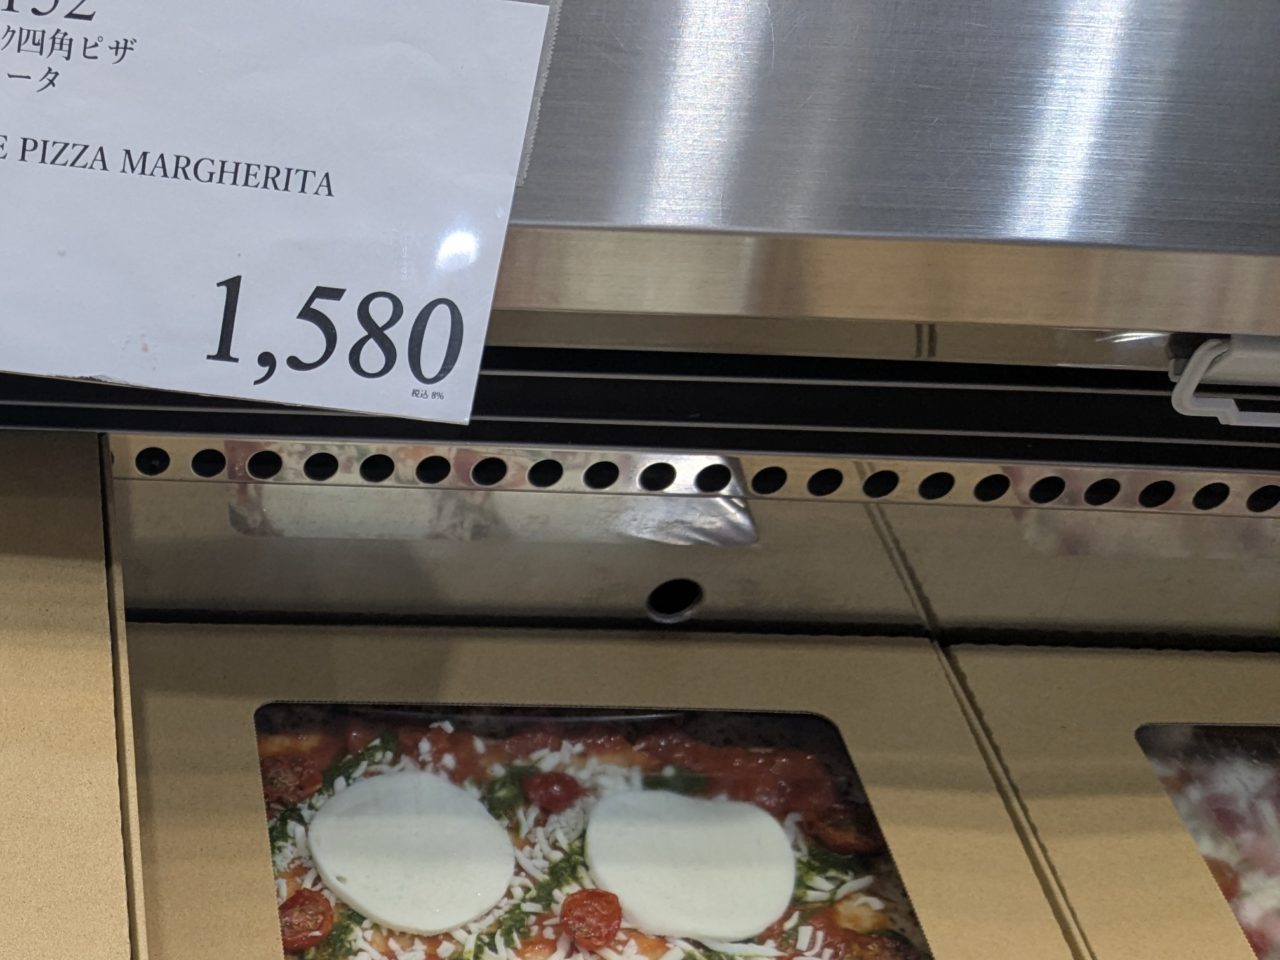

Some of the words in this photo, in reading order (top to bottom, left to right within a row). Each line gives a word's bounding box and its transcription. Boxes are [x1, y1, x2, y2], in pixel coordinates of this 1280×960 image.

[18, 135, 110, 172] PIZZA
[119, 148, 336, 198] MARGHERITA
[206, 275, 464, 385] 1,580
[431, 391, 445, 401] 8%
